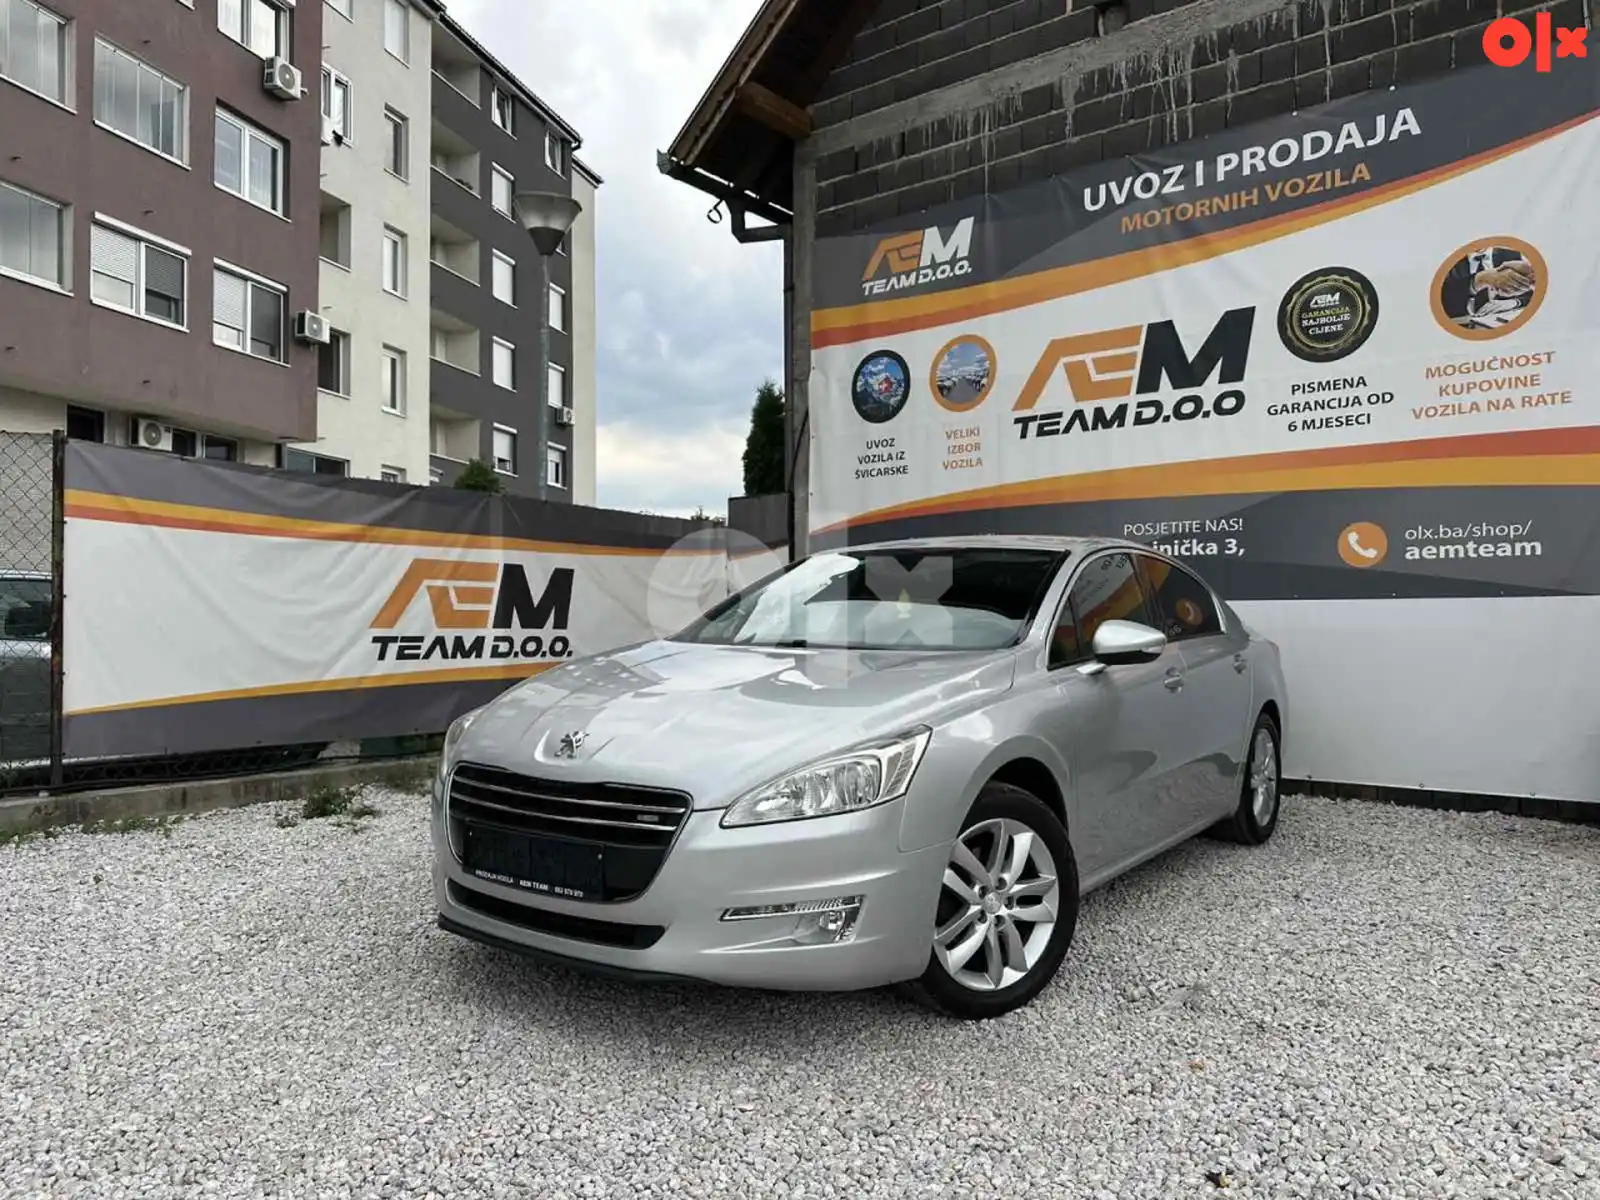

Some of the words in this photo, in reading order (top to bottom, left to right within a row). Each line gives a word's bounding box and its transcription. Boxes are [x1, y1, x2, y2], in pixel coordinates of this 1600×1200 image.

[1083, 163, 1185, 212] UVOZ
[1195, 160, 1205, 188] I
[1215, 107, 1422, 182] PRODAJA
[1121, 188, 1259, 234] MOTORNIH
[1266, 163, 1371, 201] VOZILA
[862, 272, 916, 295] TEAM
[1301, 306, 1350, 319] GARANCIJA
[1301, 313, 1351, 327] NAJBOLJE
[1308, 323, 1344, 335] CIJENE
[1291, 376, 1368, 396] PISMENA
[1438, 374, 1541, 397] KUPOVINE
[1267, 396, 1363, 416] GARANCIJA
[1367, 391, 1395, 406] OD
[1412, 401, 1482, 420] VOZILA
[1487, 399, 1516, 413] NA
[1521, 391, 1573, 409] RATE
[1013, 403, 1129, 439] TEAM
[1133, 390, 1246, 427] D.O.O
[1287, 421, 1298, 432] 6
[1301, 413, 1372, 431] MJESECI
[945, 426, 980, 440] VELIKI
[866, 437, 895, 450] UVOZ
[948, 442, 981, 455] IZBOR
[857, 453, 893, 465] VOZILA
[896, 451, 905, 461] IZ
[943, 457, 983, 470] VOZILA
[855, 465, 908, 480] ŠVICARSKE
[1124, 520, 1201, 536] POSJETITE
[1205, 518, 1243, 532] NAS!
[1405, 519, 1533, 540] olx.ba/shop/
[1405, 540, 1542, 560] aemteam
[371, 636, 486, 661] TEAM
[490, 636, 573, 658] D.O.O.
